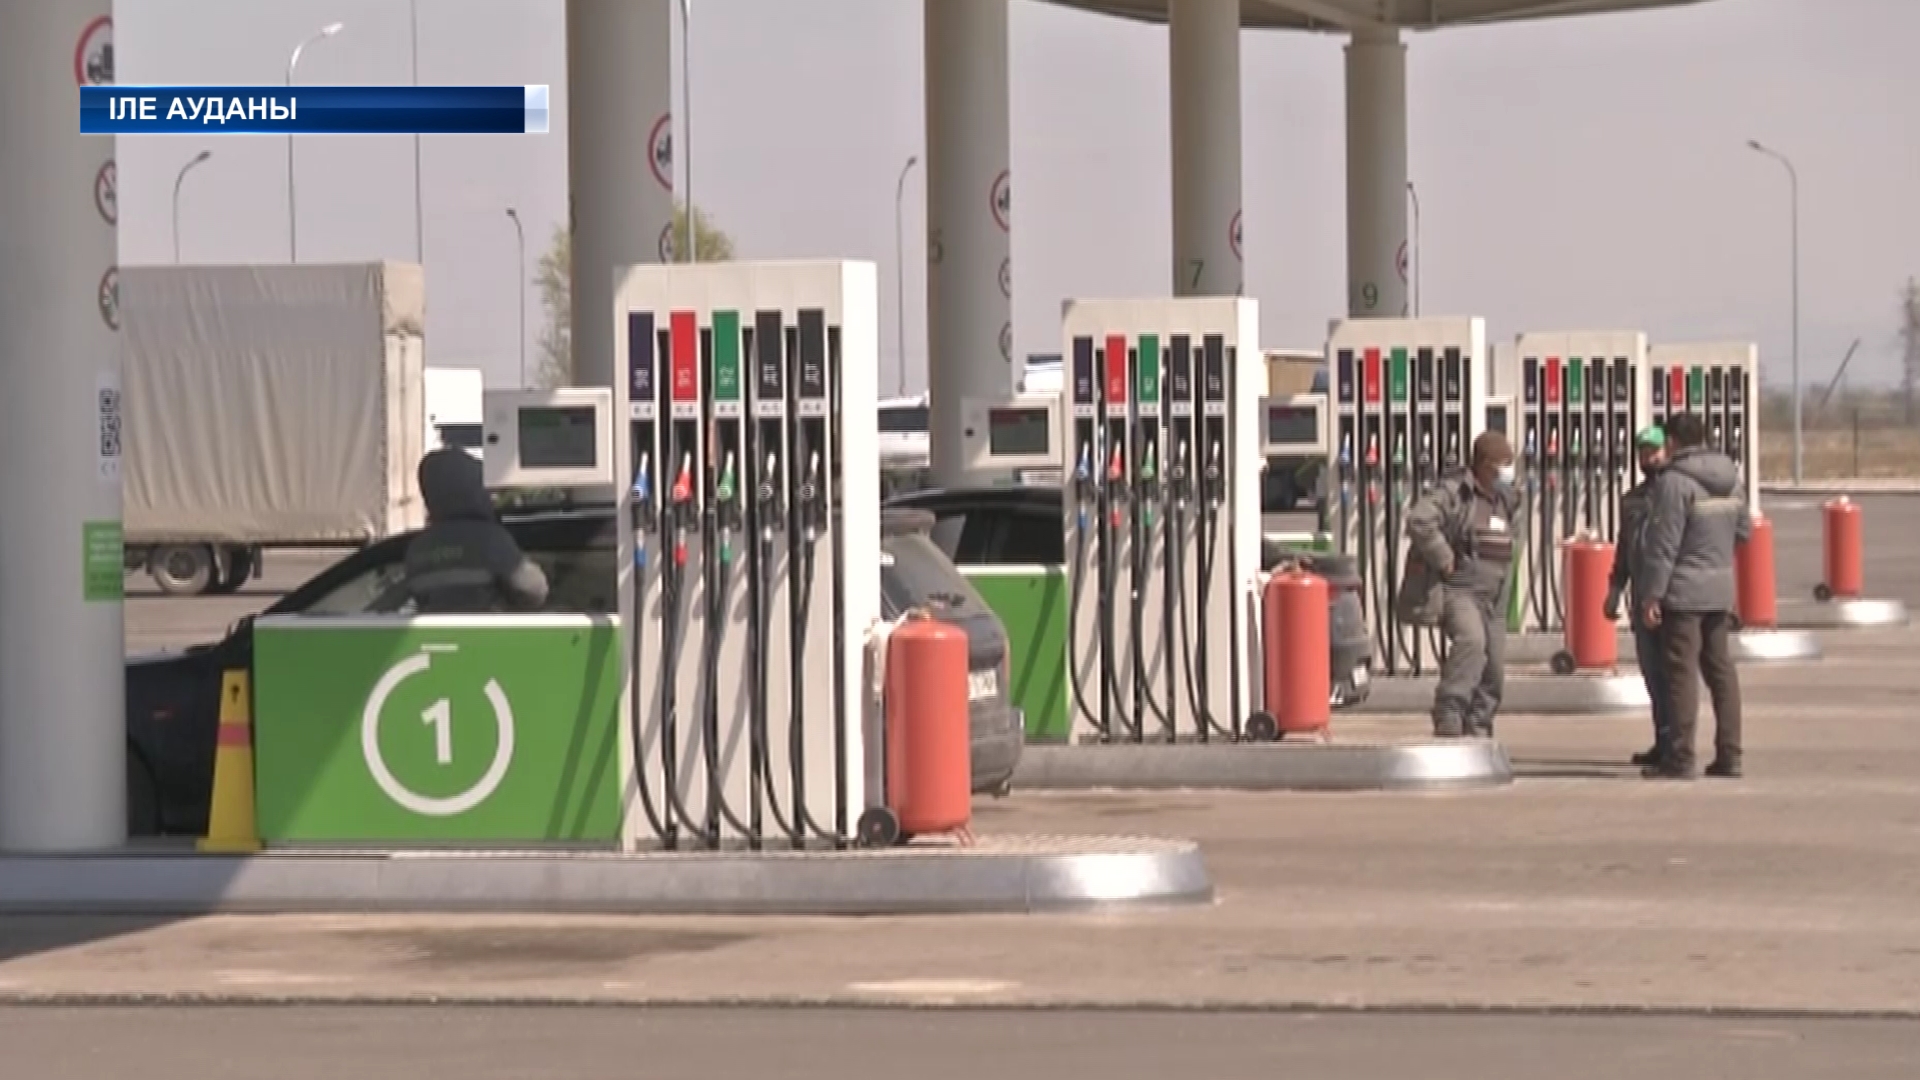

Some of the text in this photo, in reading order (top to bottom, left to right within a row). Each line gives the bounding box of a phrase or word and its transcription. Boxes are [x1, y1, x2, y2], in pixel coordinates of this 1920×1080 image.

[1189, 260, 1204, 288] 7
[1362, 283, 1378, 308] 9
[720, 366, 734, 386] 92
[420, 697, 452, 764] 1
